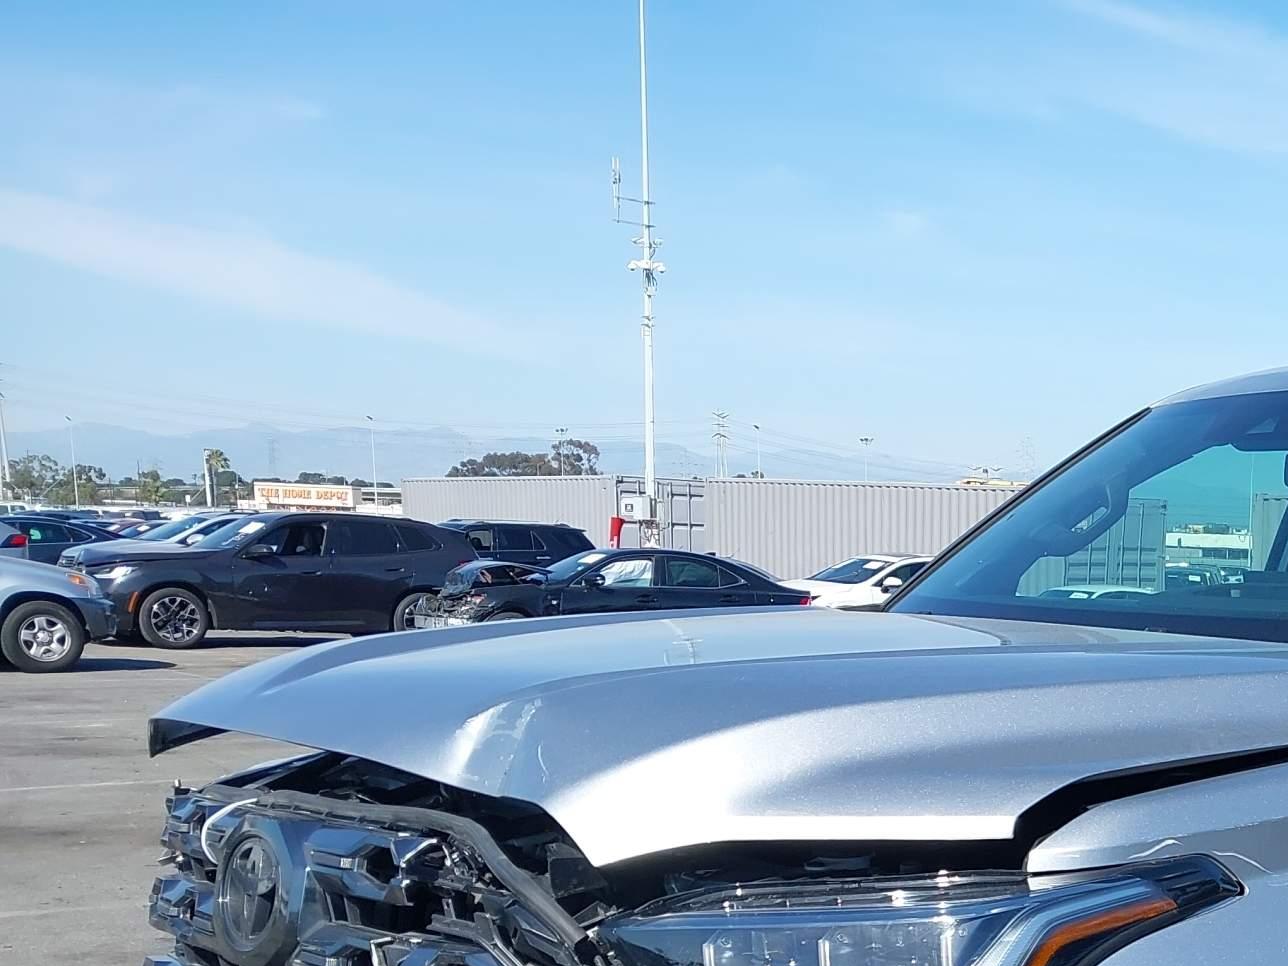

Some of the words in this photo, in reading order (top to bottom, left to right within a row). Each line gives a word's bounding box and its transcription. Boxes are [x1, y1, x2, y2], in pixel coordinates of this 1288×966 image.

[257, 488, 280, 498] THE
[282, 488, 312, 499] HOME
[316, 490, 348, 501] DEPOT
